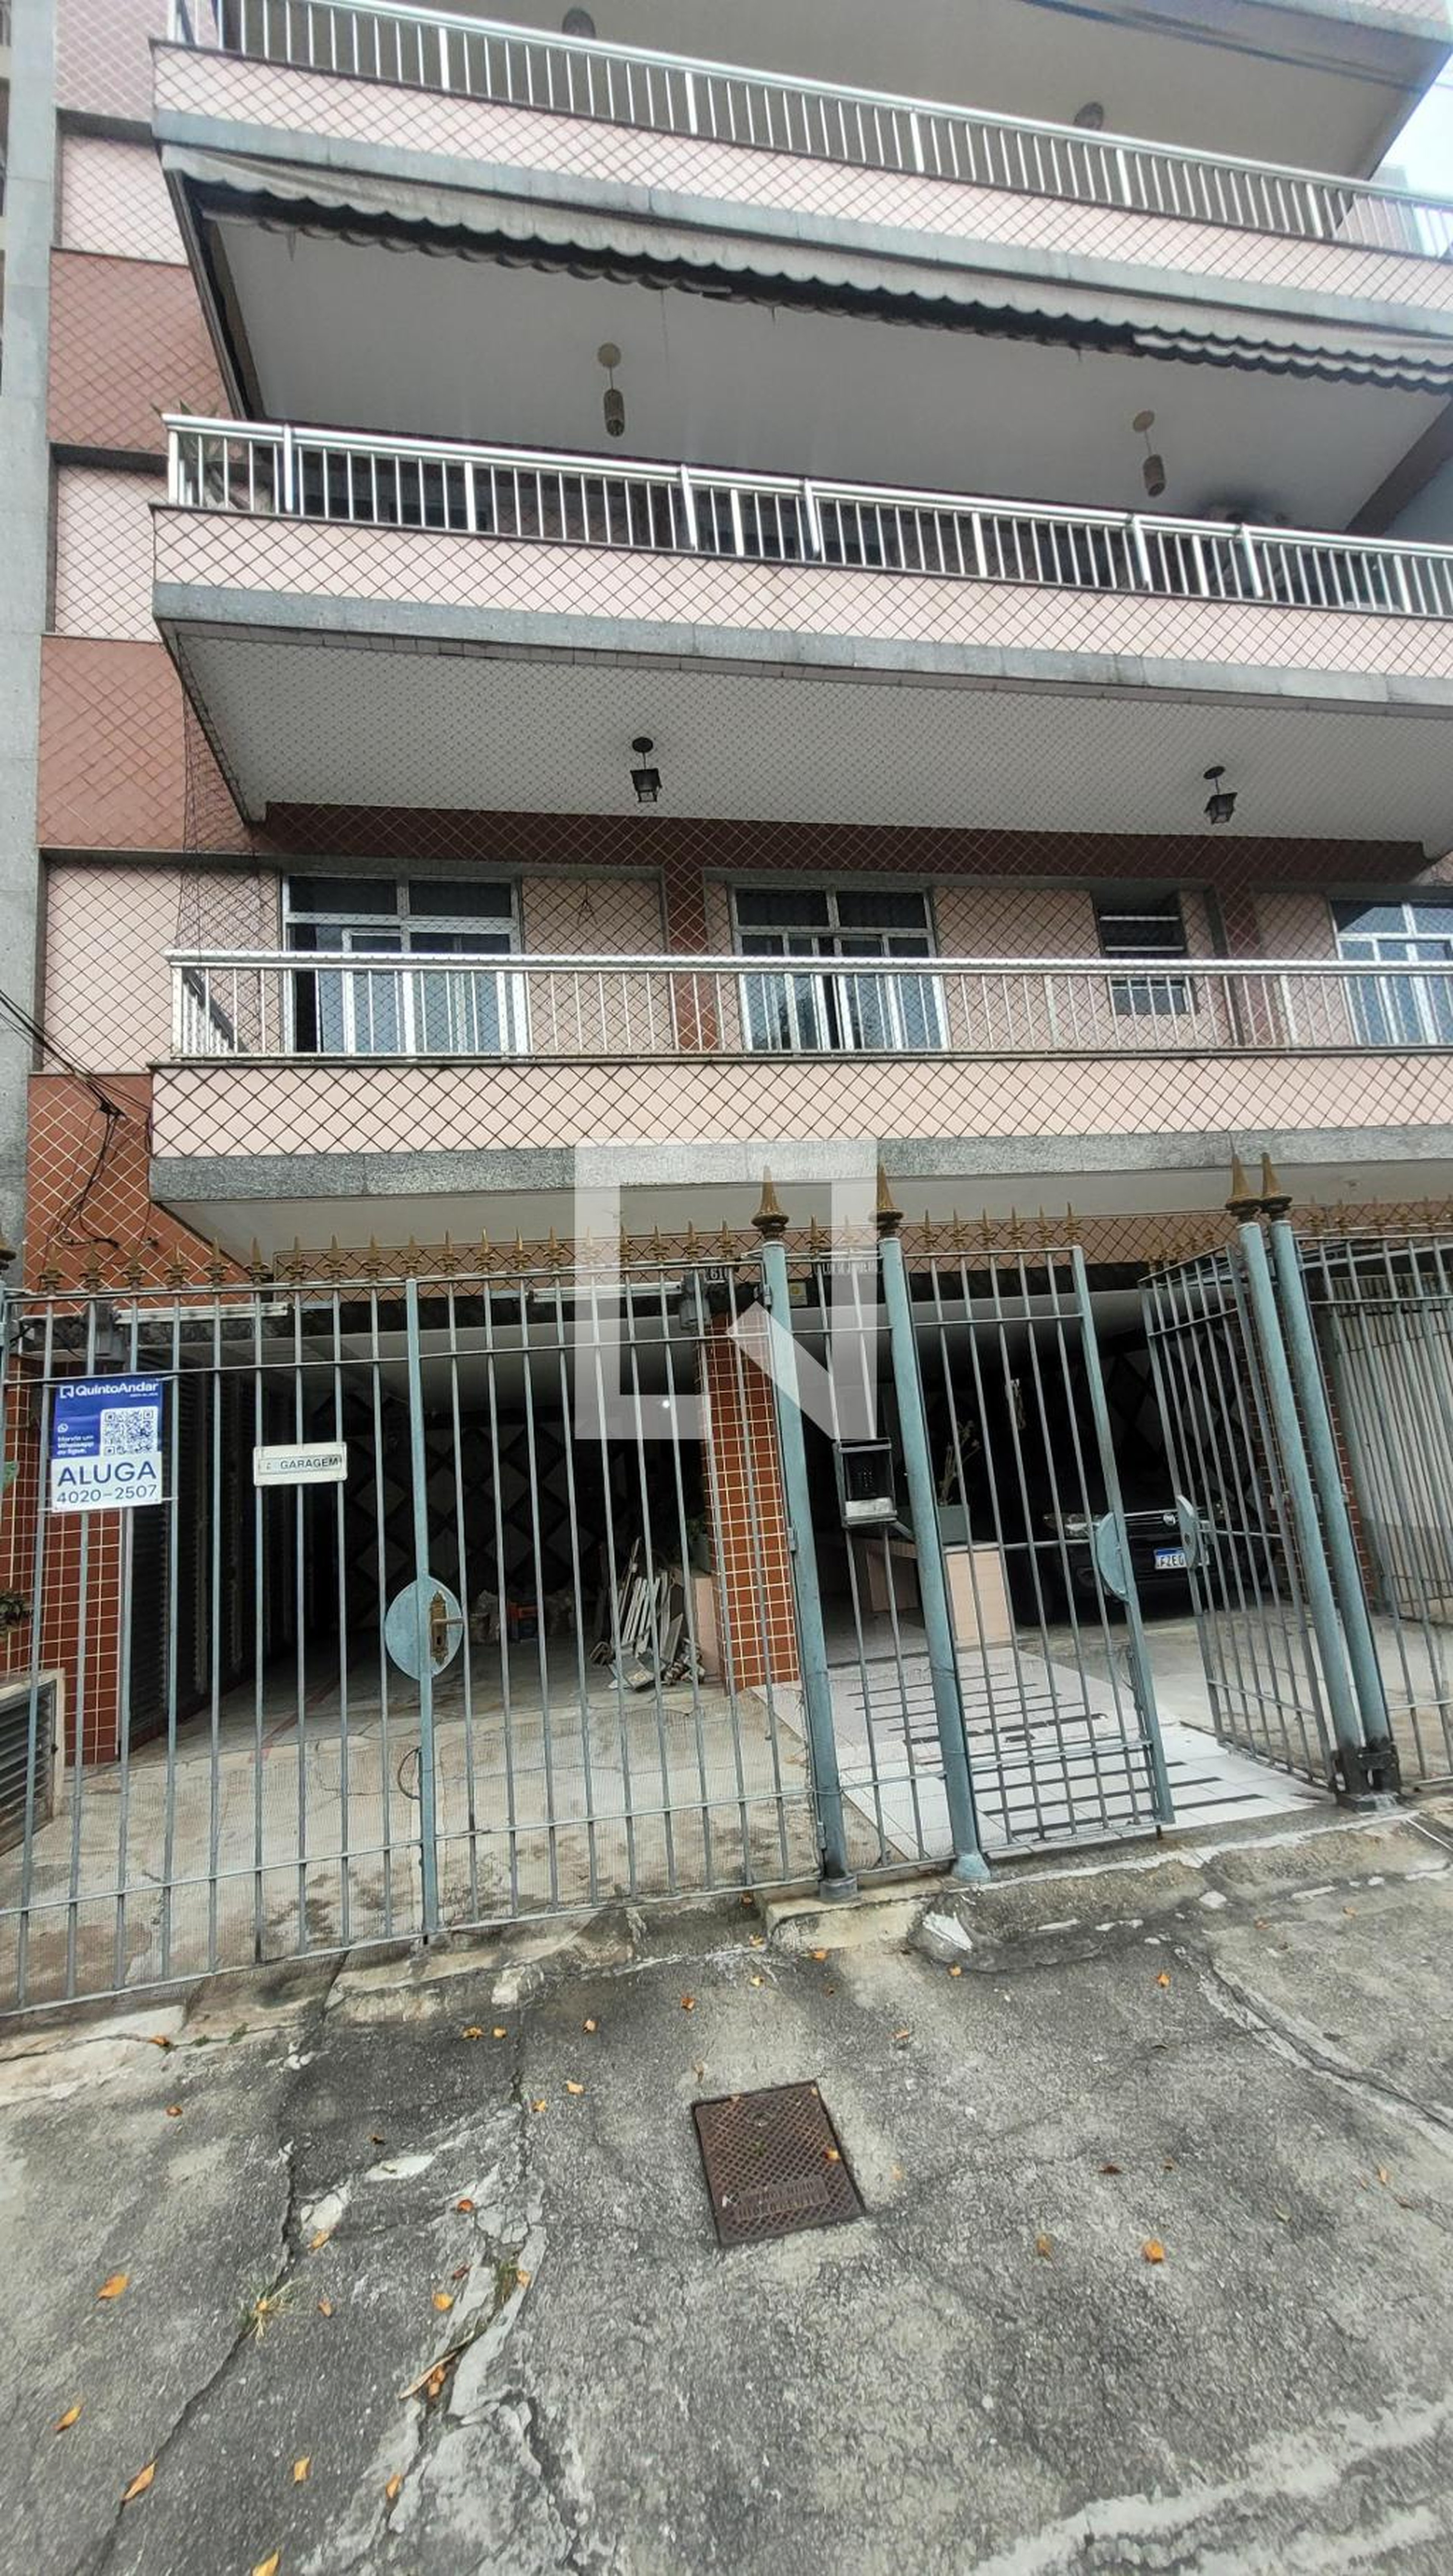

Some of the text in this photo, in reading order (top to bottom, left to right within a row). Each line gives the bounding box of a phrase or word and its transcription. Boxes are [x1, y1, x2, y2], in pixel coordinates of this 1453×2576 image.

[76, 1382, 159, 1396] QuintoAndar
[280, 1457, 339, 1469] GARAGEM
[58, 1461, 157, 1487] ALUGA
[57, 1484, 157, 1503] 4020-2507
